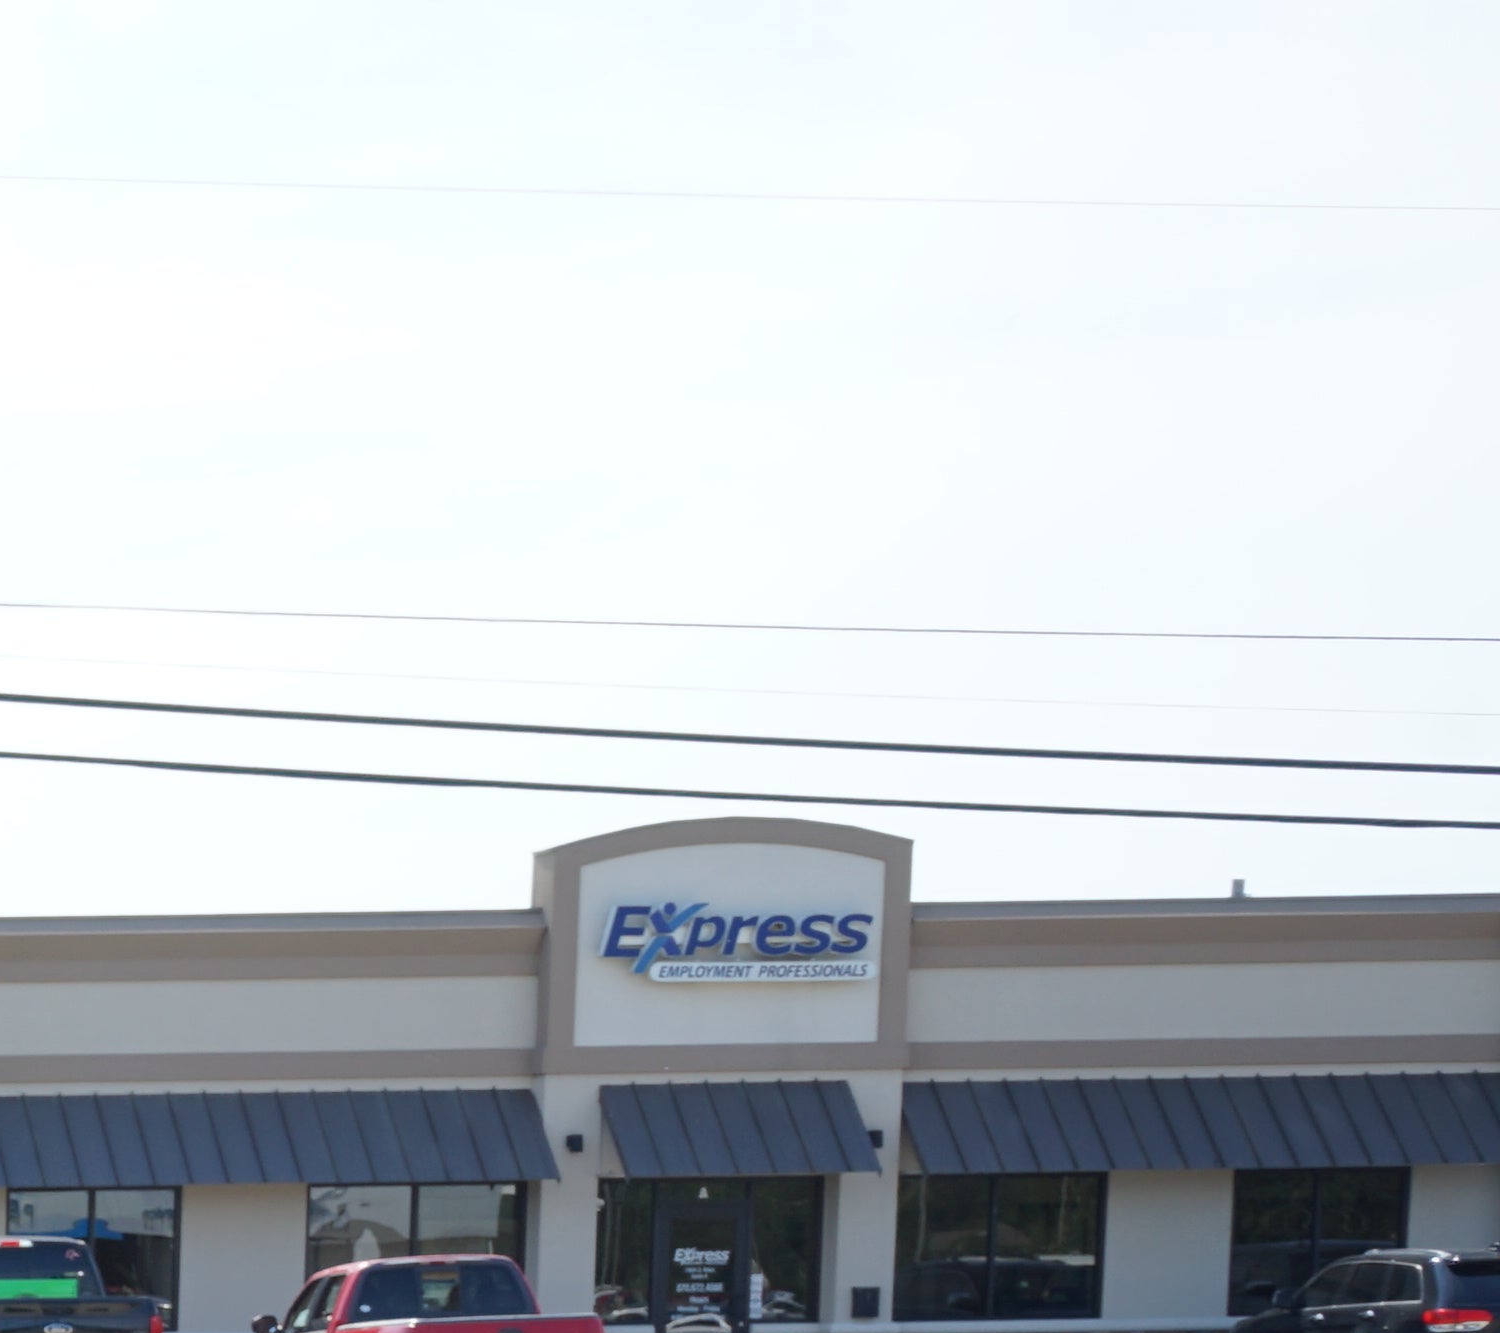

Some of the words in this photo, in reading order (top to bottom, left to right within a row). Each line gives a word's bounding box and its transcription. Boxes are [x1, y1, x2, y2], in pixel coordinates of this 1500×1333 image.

[600, 902, 874, 974] Express
[657, 964, 753, 979] EMPLOYMENT
[757, 963, 868, 979] PROFESSIONALS
